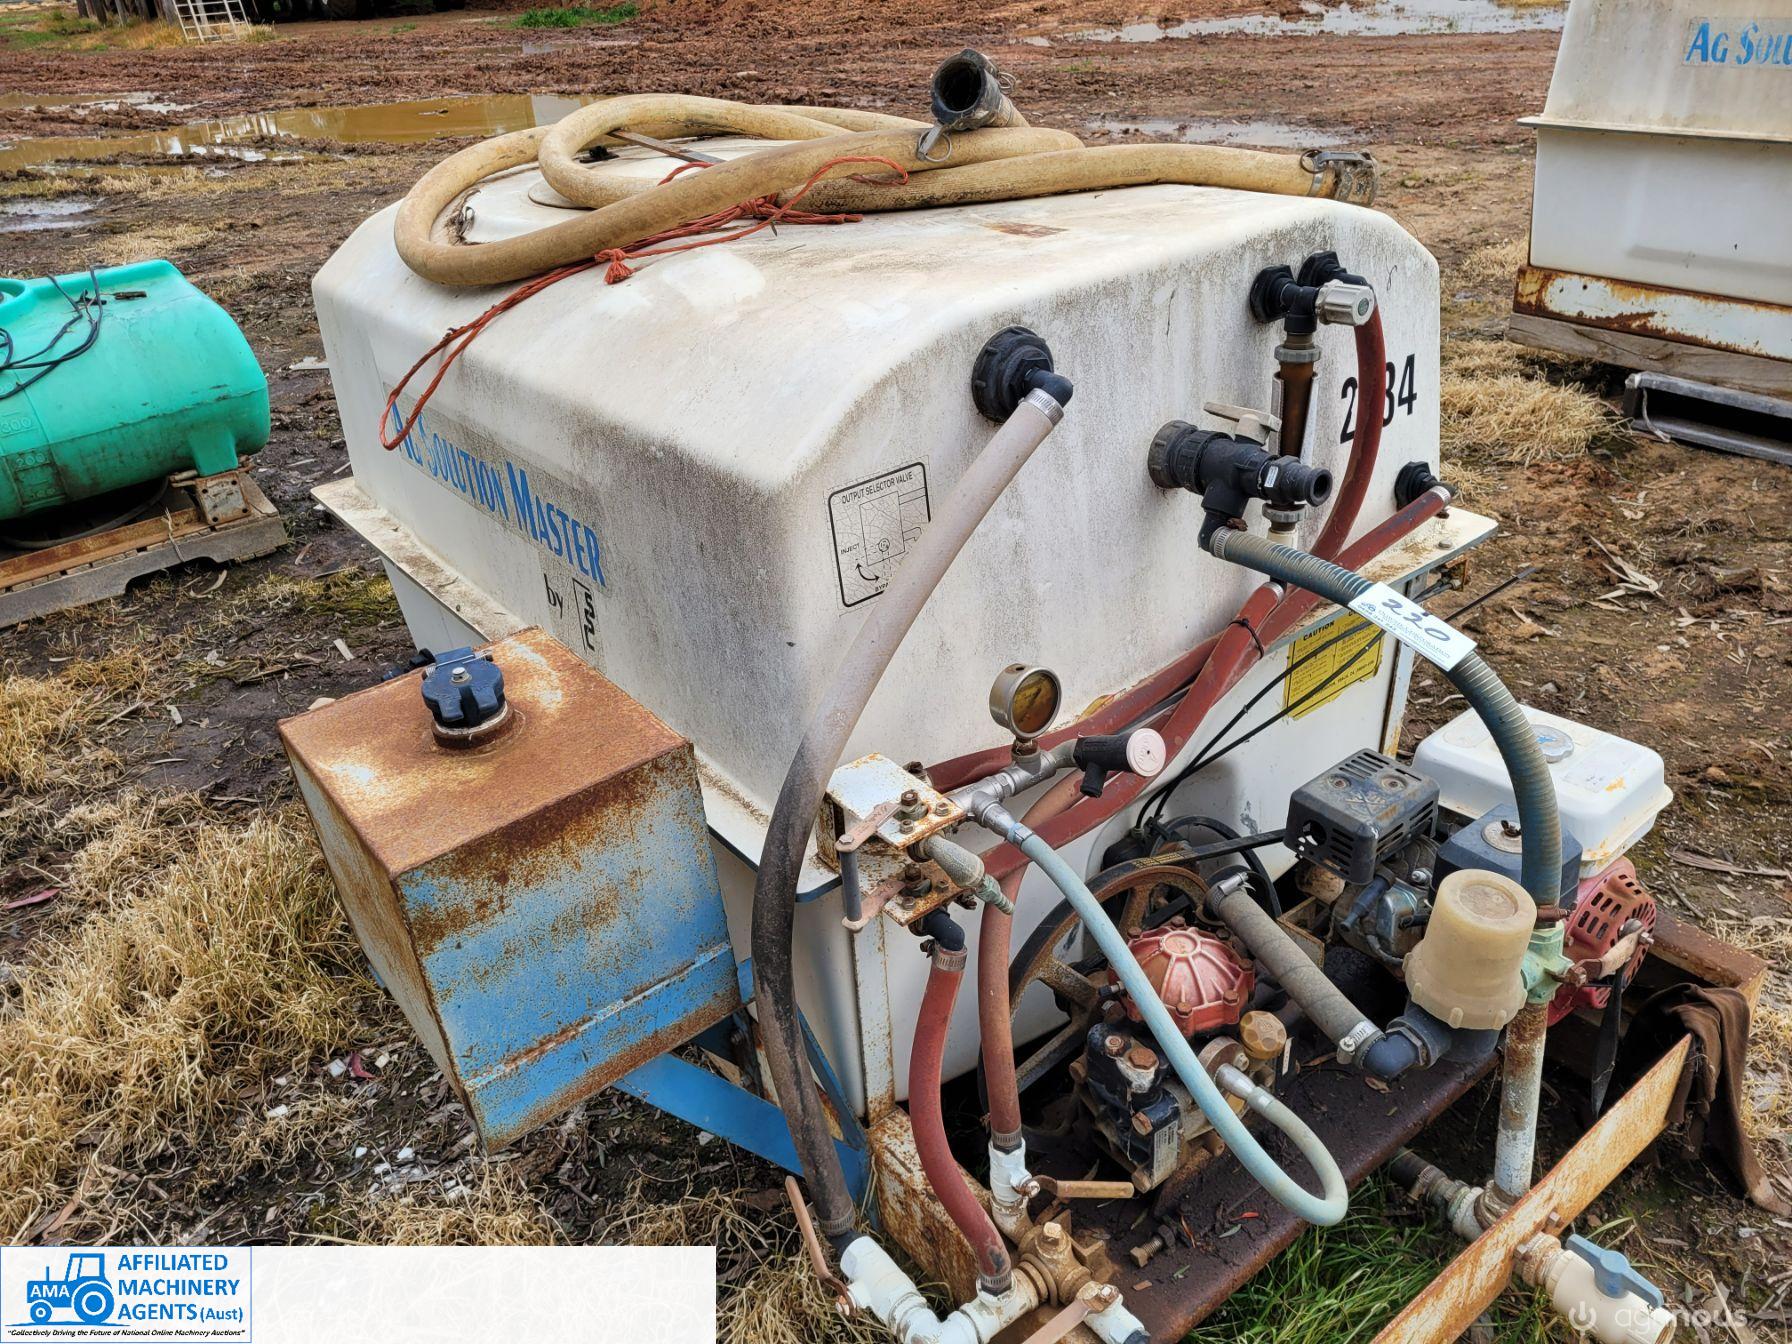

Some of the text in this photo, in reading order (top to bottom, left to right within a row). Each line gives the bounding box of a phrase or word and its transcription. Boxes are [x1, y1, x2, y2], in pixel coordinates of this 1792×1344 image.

[1685, 22, 1729, 63] AG
[417, 411, 510, 522] SOLUTION
[506, 460, 606, 588] MASTER
[841, 471, 914, 504] OUTPUT SELECTOR VALVE
[840, 542, 860, 555] INJECT
[543, 572, 564, 619] by
[1303, 620, 1335, 641] CAUTION
